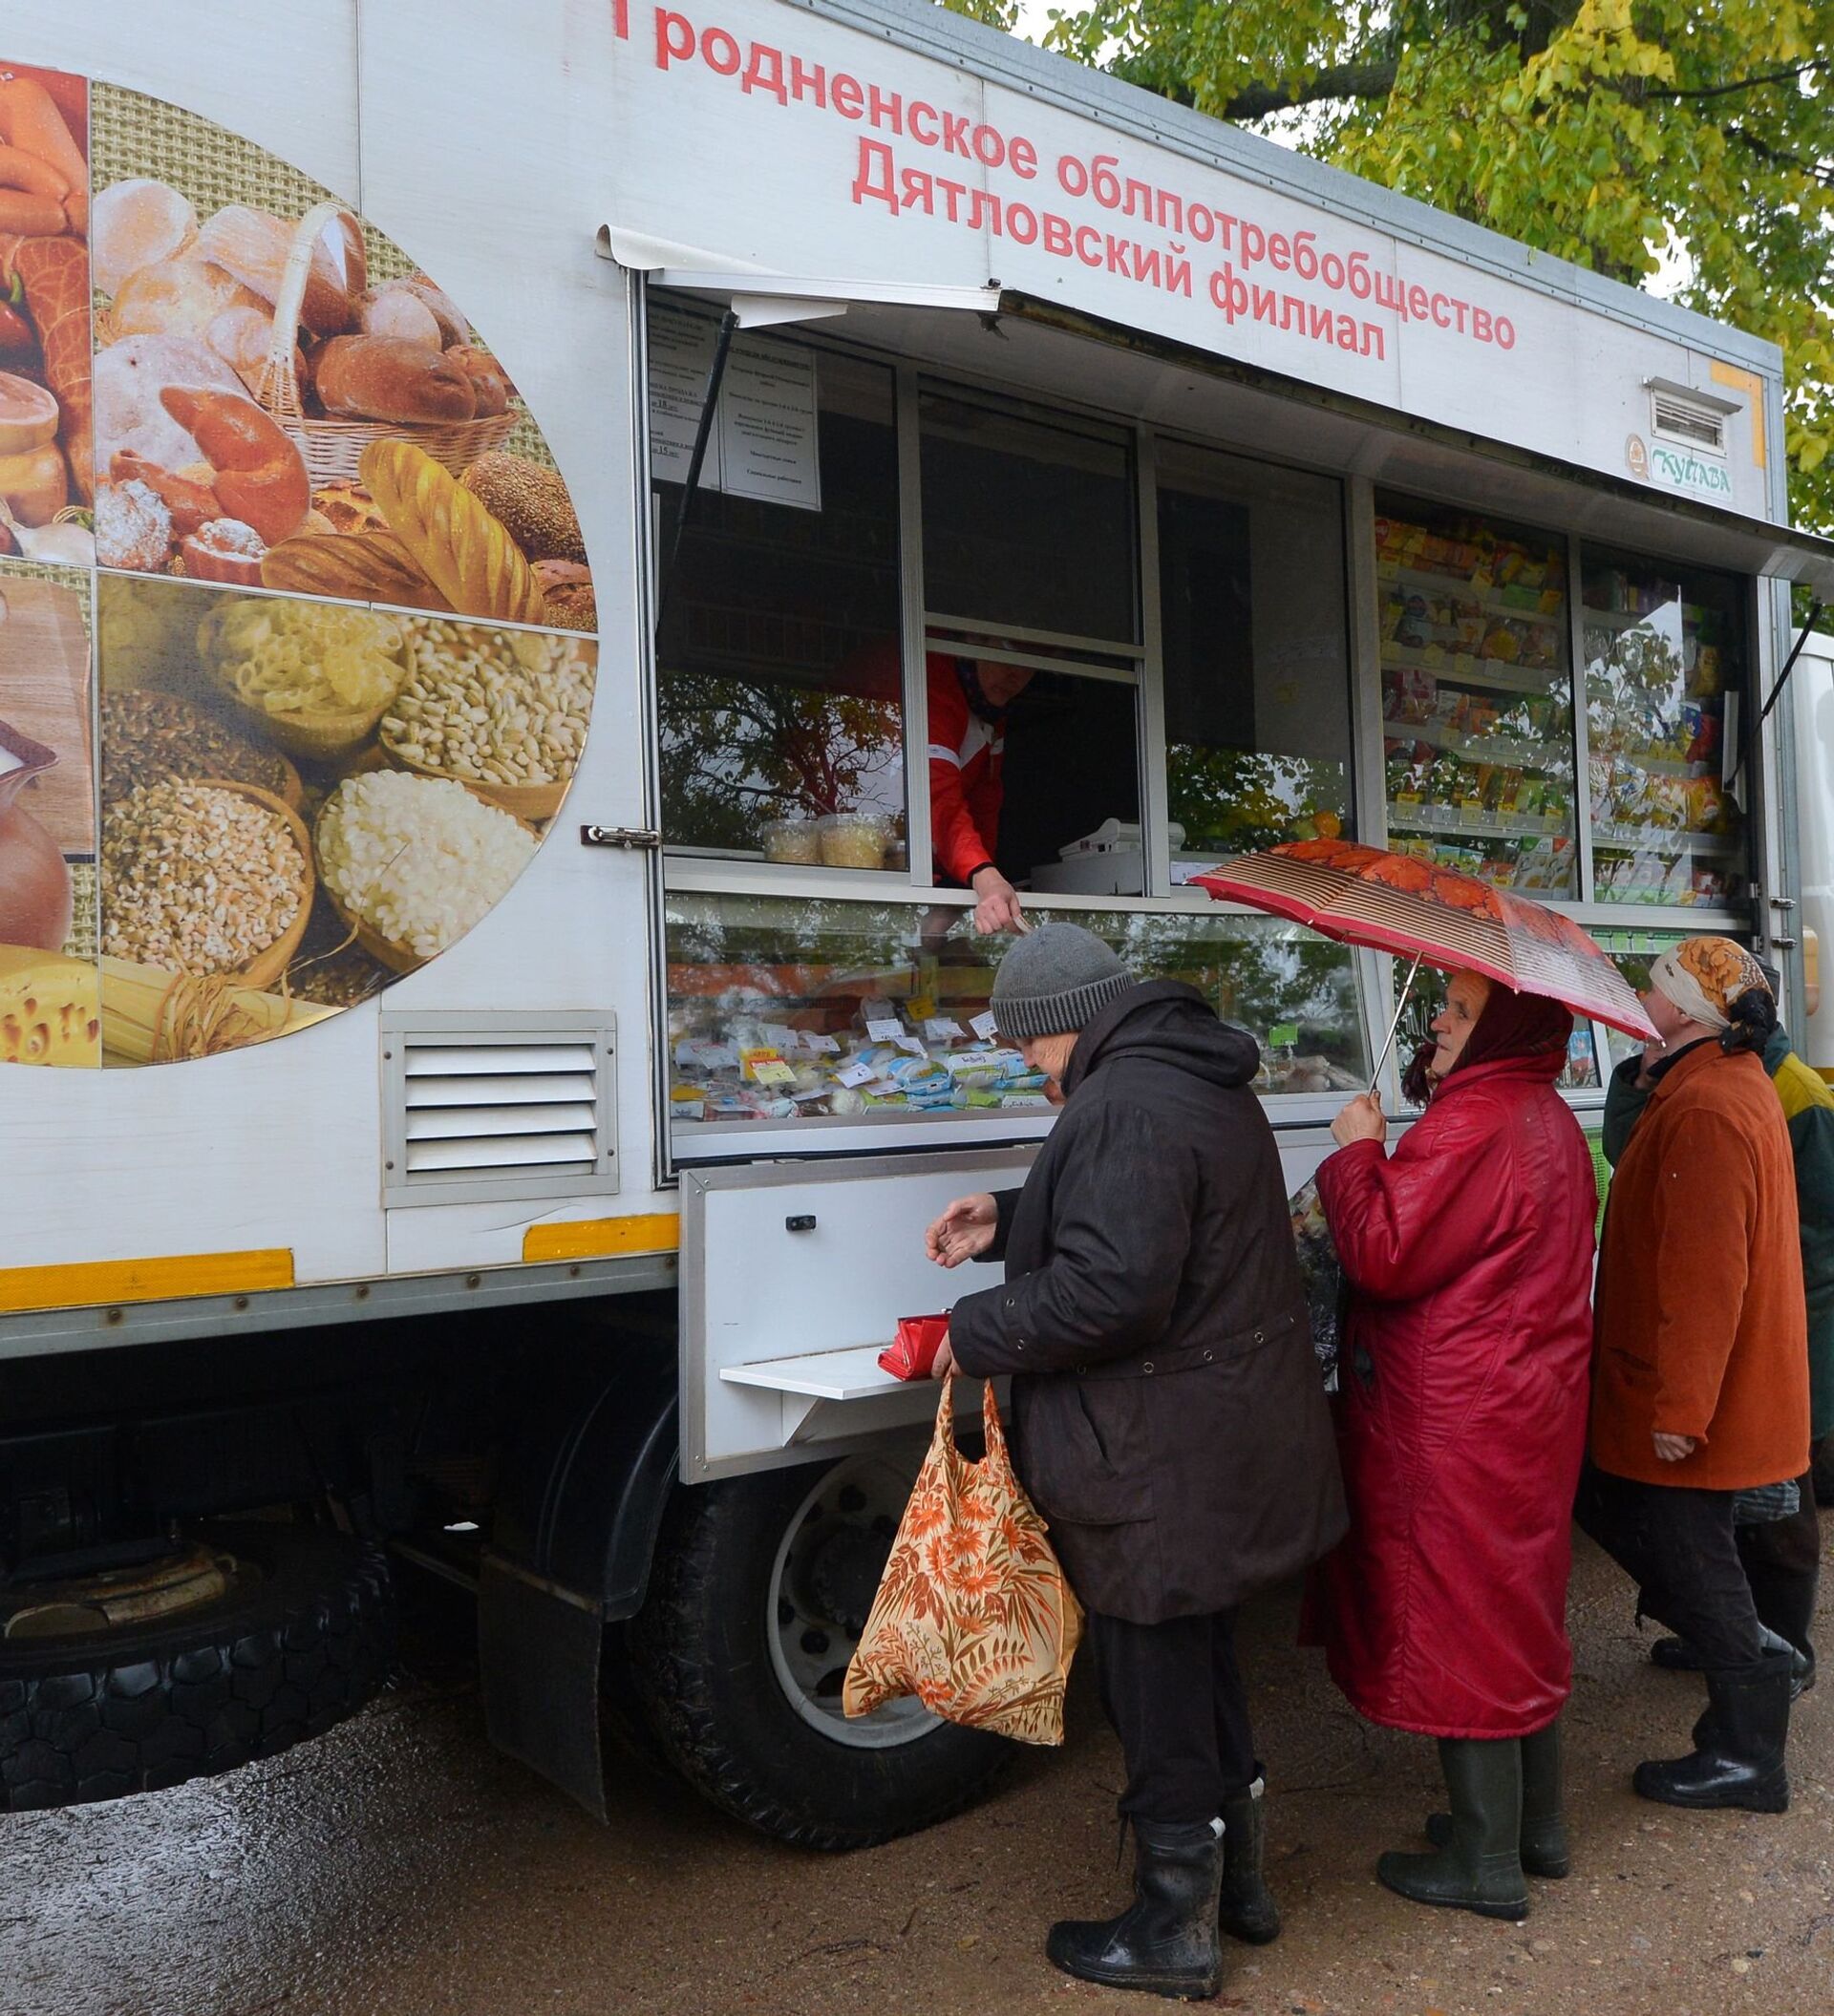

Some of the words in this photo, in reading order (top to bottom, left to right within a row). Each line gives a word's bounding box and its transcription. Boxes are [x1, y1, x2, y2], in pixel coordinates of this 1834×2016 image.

[852, 136, 1192, 298] Дятловский
[1209, 262, 1385, 361] филиал
[1057, 155, 1516, 350] облпотребобщество
